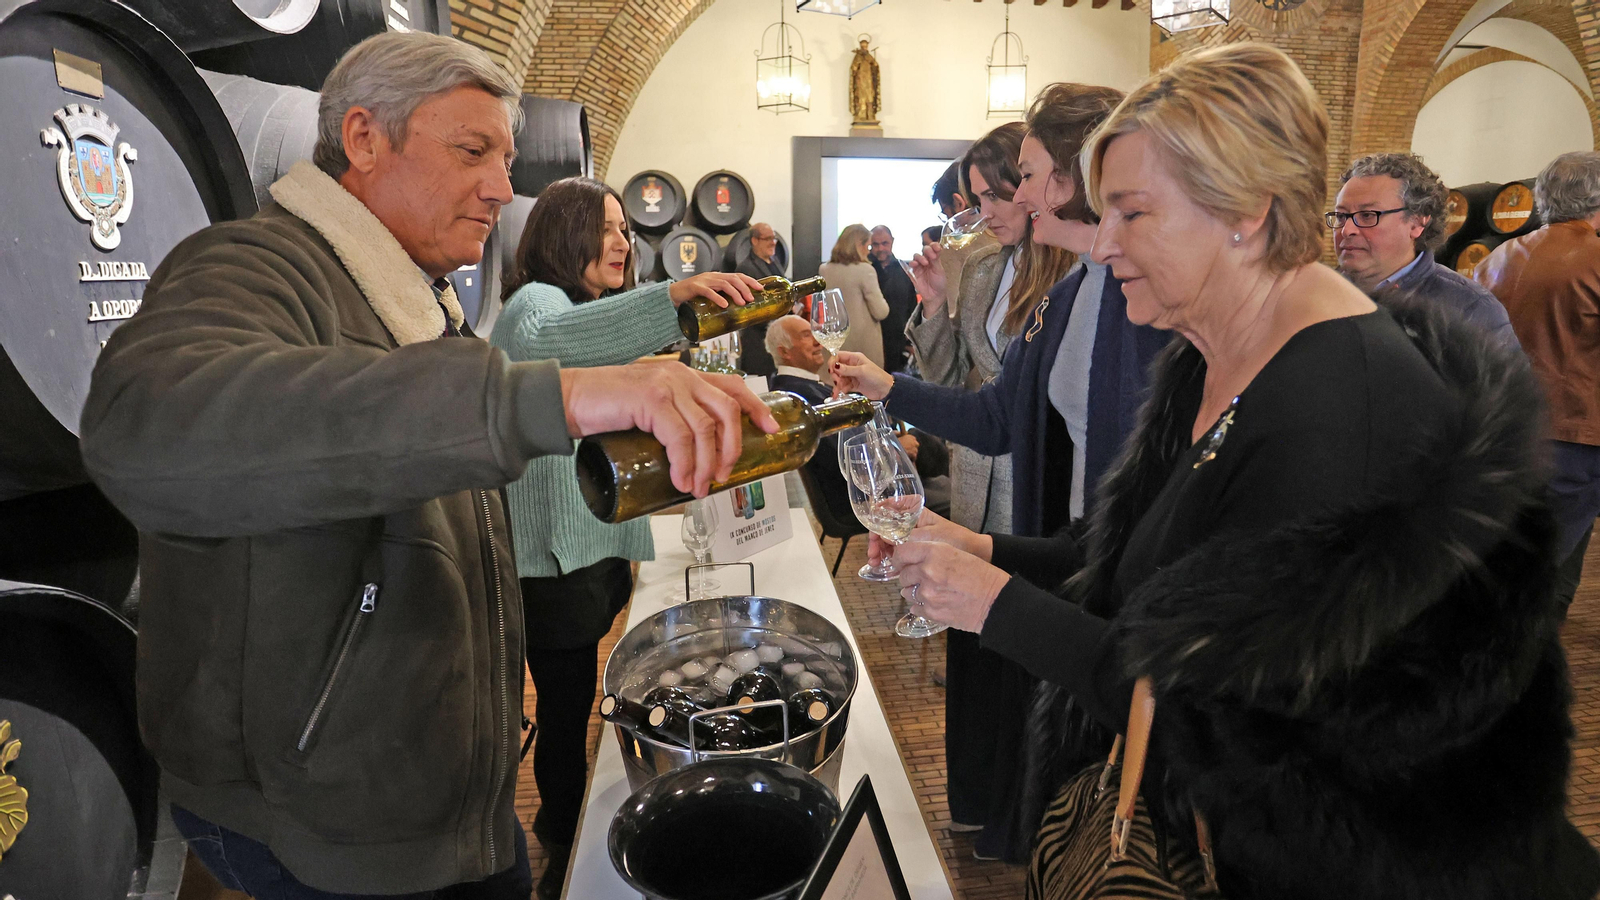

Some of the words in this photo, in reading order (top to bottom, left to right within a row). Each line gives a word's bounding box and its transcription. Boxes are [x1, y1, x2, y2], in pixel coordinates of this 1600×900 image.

[79, 261, 150, 280] DDICADA
[90, 301, 101, 319] A
[735, 523, 756, 537] CONCURSO
[756, 521, 762, 530] DE
[762, 515, 776, 526] MOSTOS
[736, 538, 744, 546] DEL
